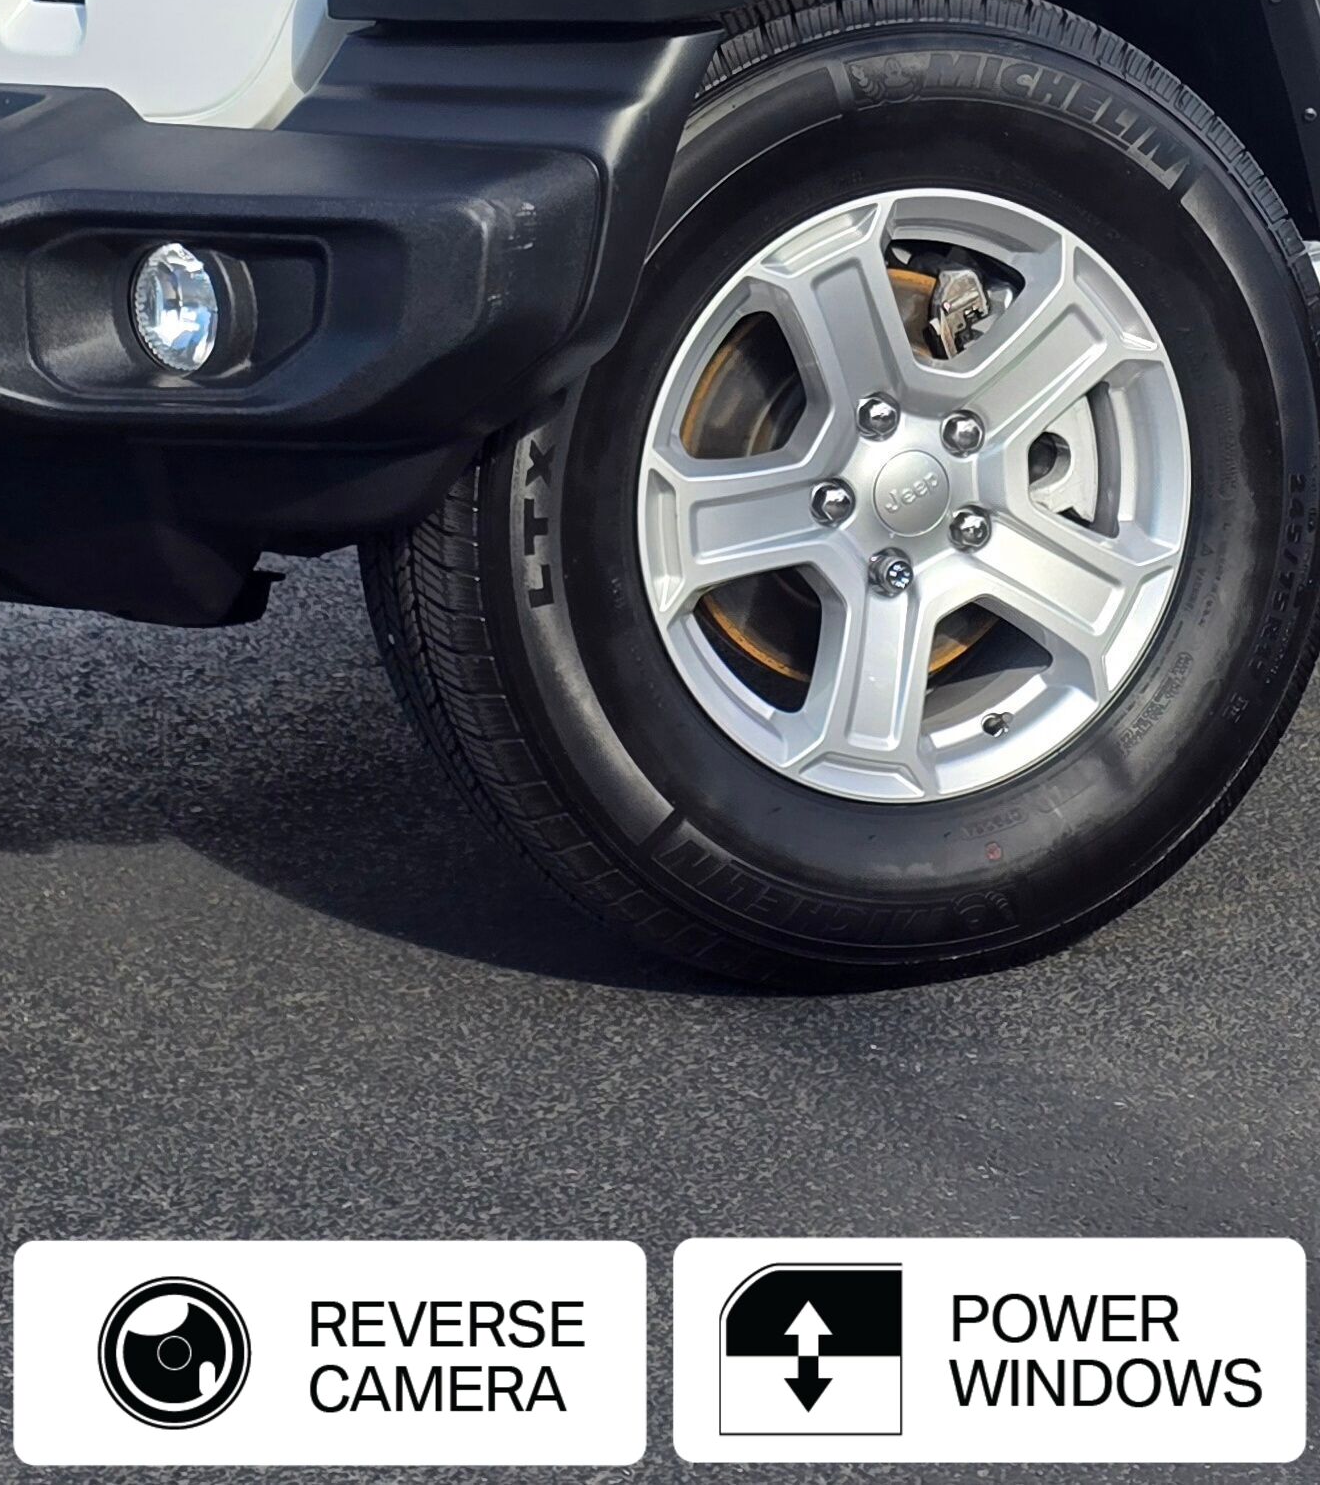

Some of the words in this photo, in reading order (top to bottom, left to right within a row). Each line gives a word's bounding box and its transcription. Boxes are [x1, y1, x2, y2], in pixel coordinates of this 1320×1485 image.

[923, 51, 1190, 187] MICHELIN
[523, 439, 557, 608] LTX
[884, 471, 939, 513] Jeep
